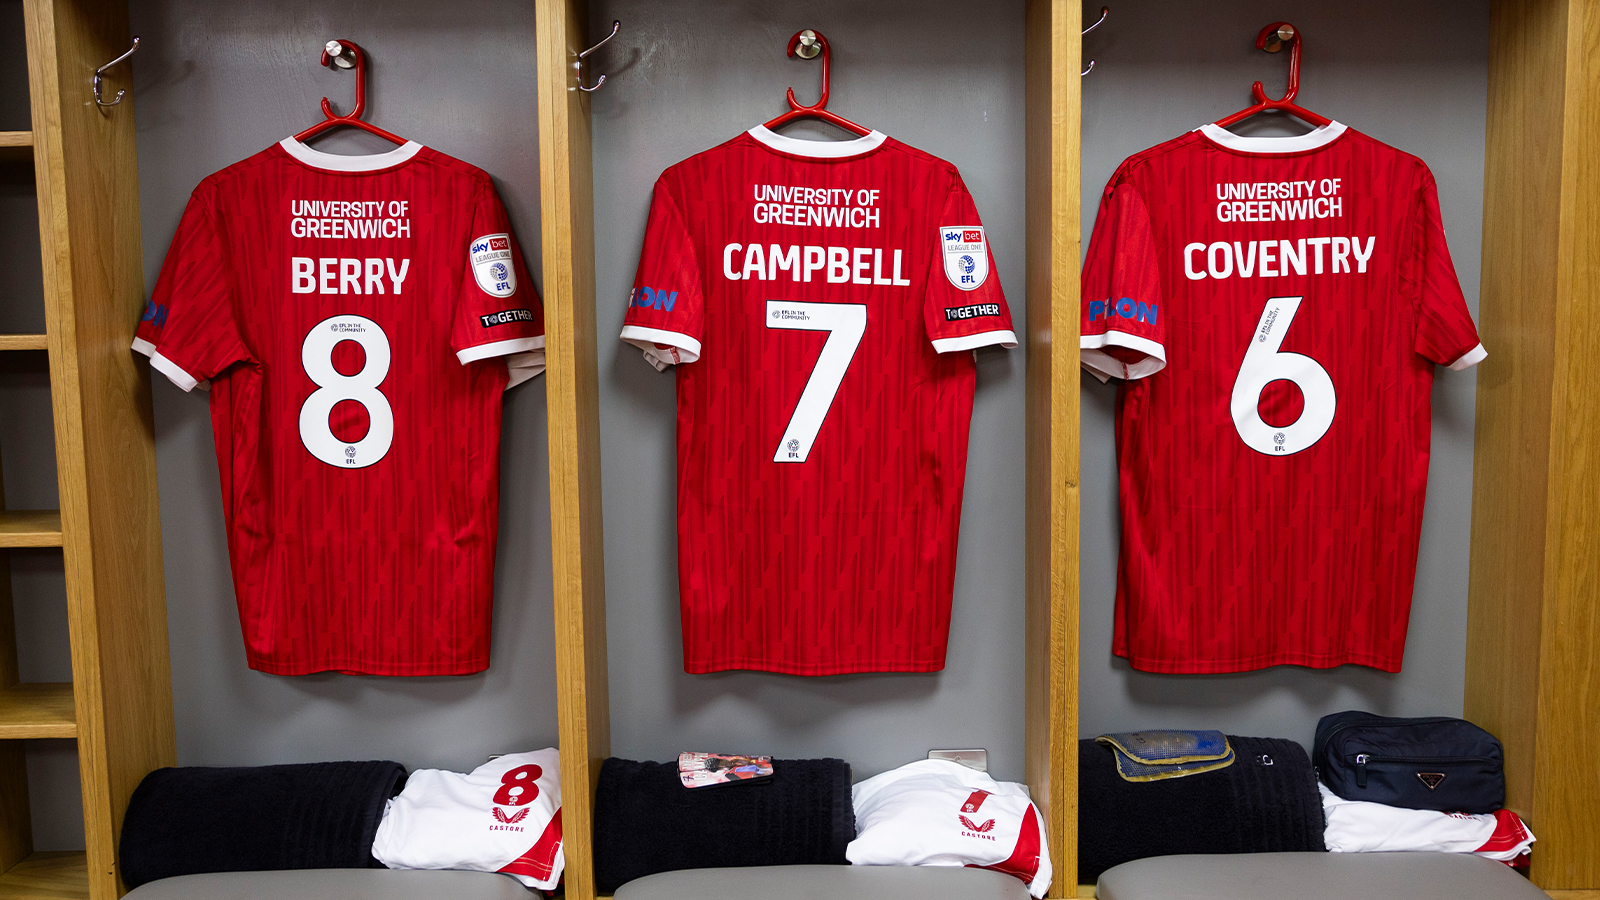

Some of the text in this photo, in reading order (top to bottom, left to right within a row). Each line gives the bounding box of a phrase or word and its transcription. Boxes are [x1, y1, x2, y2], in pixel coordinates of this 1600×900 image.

[754, 184, 880, 206] UNIVERSITY OF
[1216, 178, 1341, 200] UNIVERSITY OF
[291, 199, 408, 218] UNIVERSITY OF
[753, 203, 880, 228] GREENWICH
[1216, 197, 1342, 222] GREENWICH
[290, 217, 411, 239] GREENWICH
[945, 231, 980, 242] sky bet
[472, 240, 507, 254] sky bet
[475, 251, 500, 262] LEAGUE
[1183, 236, 1376, 280] COVENTRY
[723, 242, 910, 286] CAMPBELL
[291, 257, 410, 295] BERRY
[496, 282, 511, 291] EFL
[961, 275, 975, 283] EFL
[766, 300, 868, 464] 7
[1230, 296, 1337, 457] 6
[299, 314, 395, 469] 8
[493, 764, 543, 806] 8
[489, 825, 524, 833] CASTORE
[961, 831, 996, 842] CASTORE
